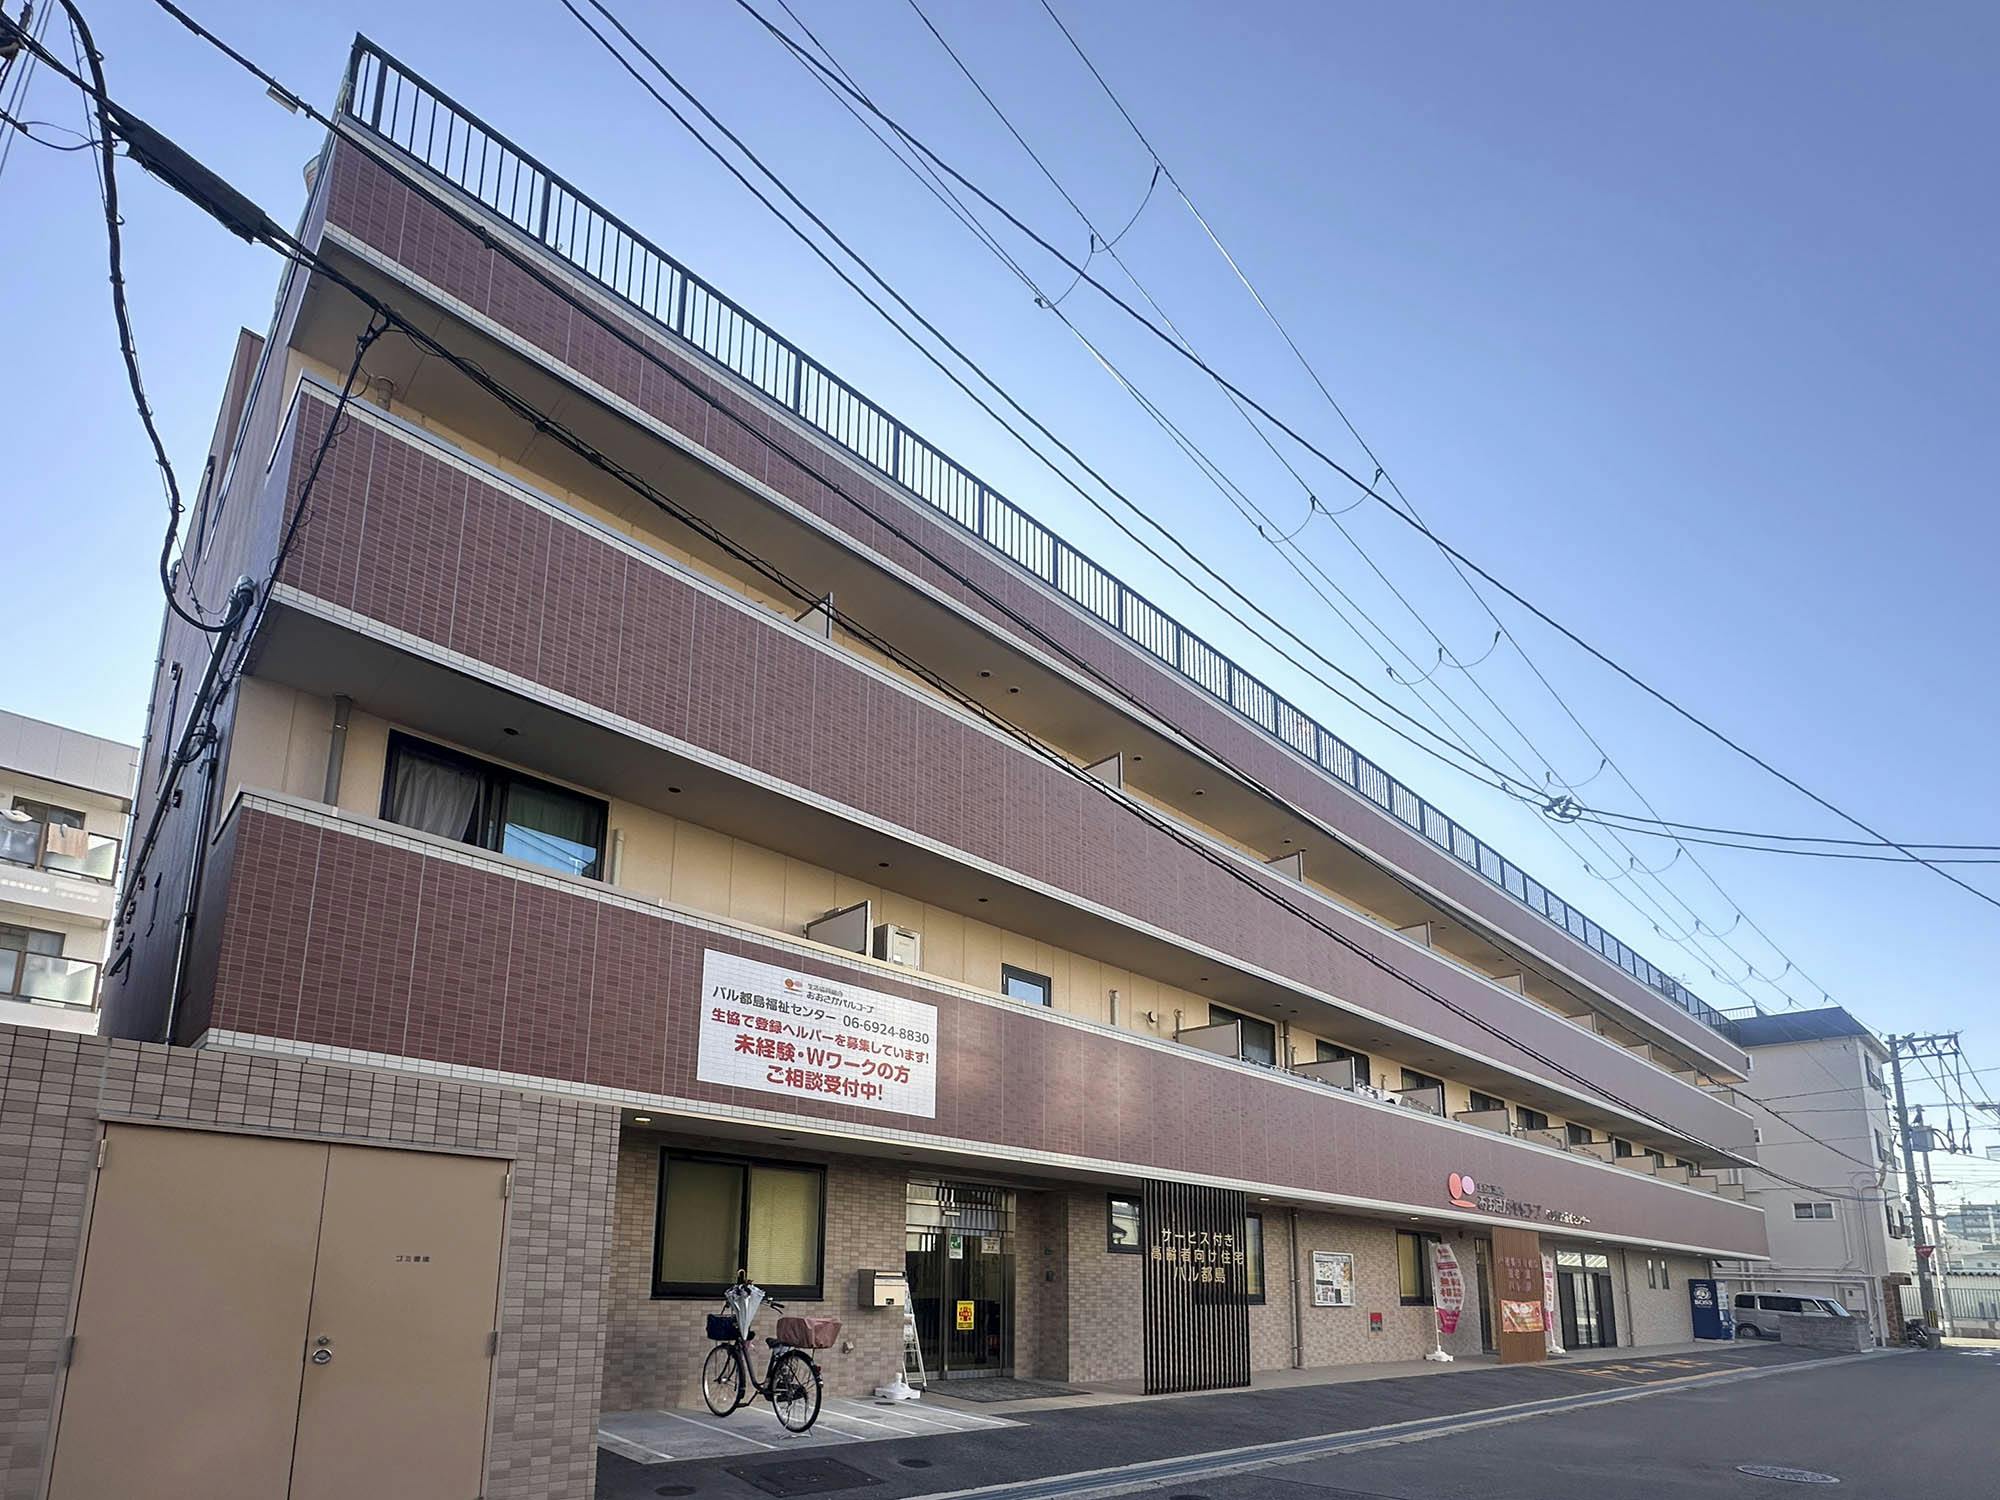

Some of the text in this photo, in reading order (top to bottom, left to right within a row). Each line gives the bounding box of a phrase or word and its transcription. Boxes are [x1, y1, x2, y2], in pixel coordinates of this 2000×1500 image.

[843, 1014, 930, 1045] 06-6924-8830
[734, 1033, 912, 1085] 未経験・Wワークの方
[766, 1064, 884, 1101] ご相談受付中!
